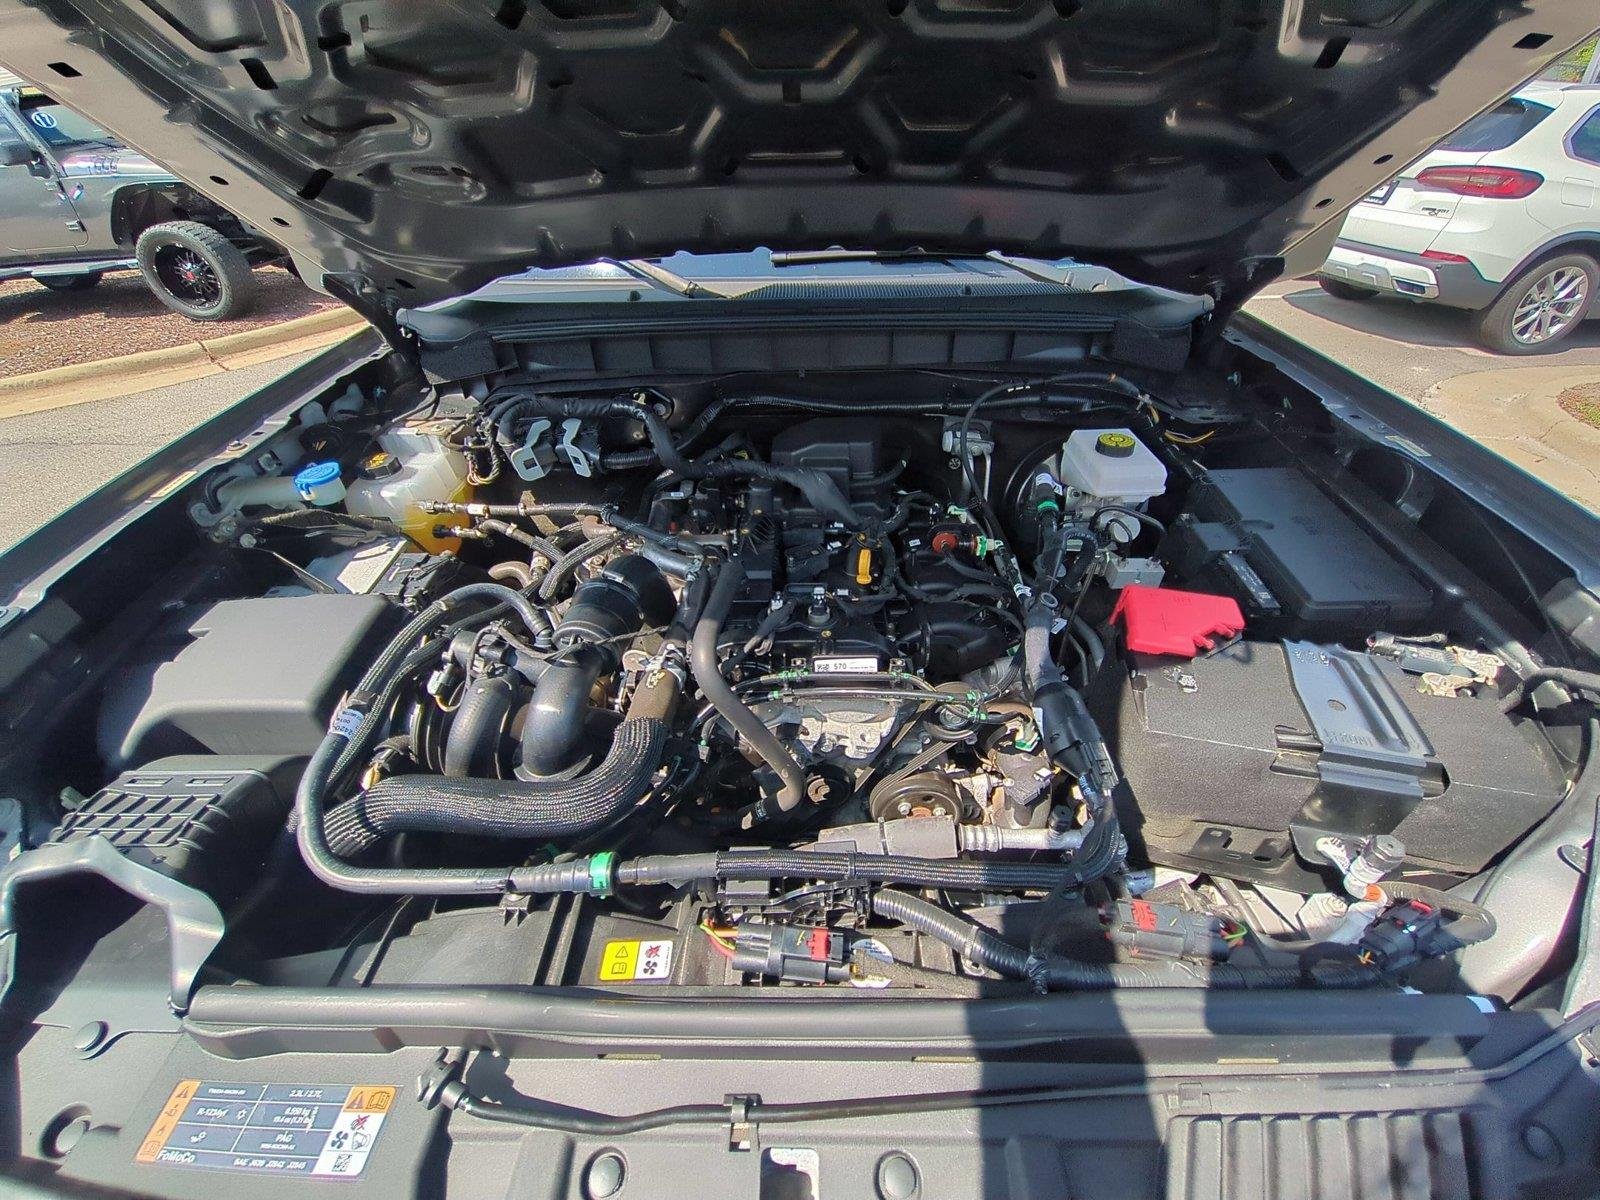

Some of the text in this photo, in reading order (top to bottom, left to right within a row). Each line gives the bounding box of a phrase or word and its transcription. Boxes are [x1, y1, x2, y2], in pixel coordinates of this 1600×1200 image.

[275, 1133, 293, 1143] PAG
[156, 1149, 196, 1164] FoMoCo
[234, 1158, 248, 1167] SAE
